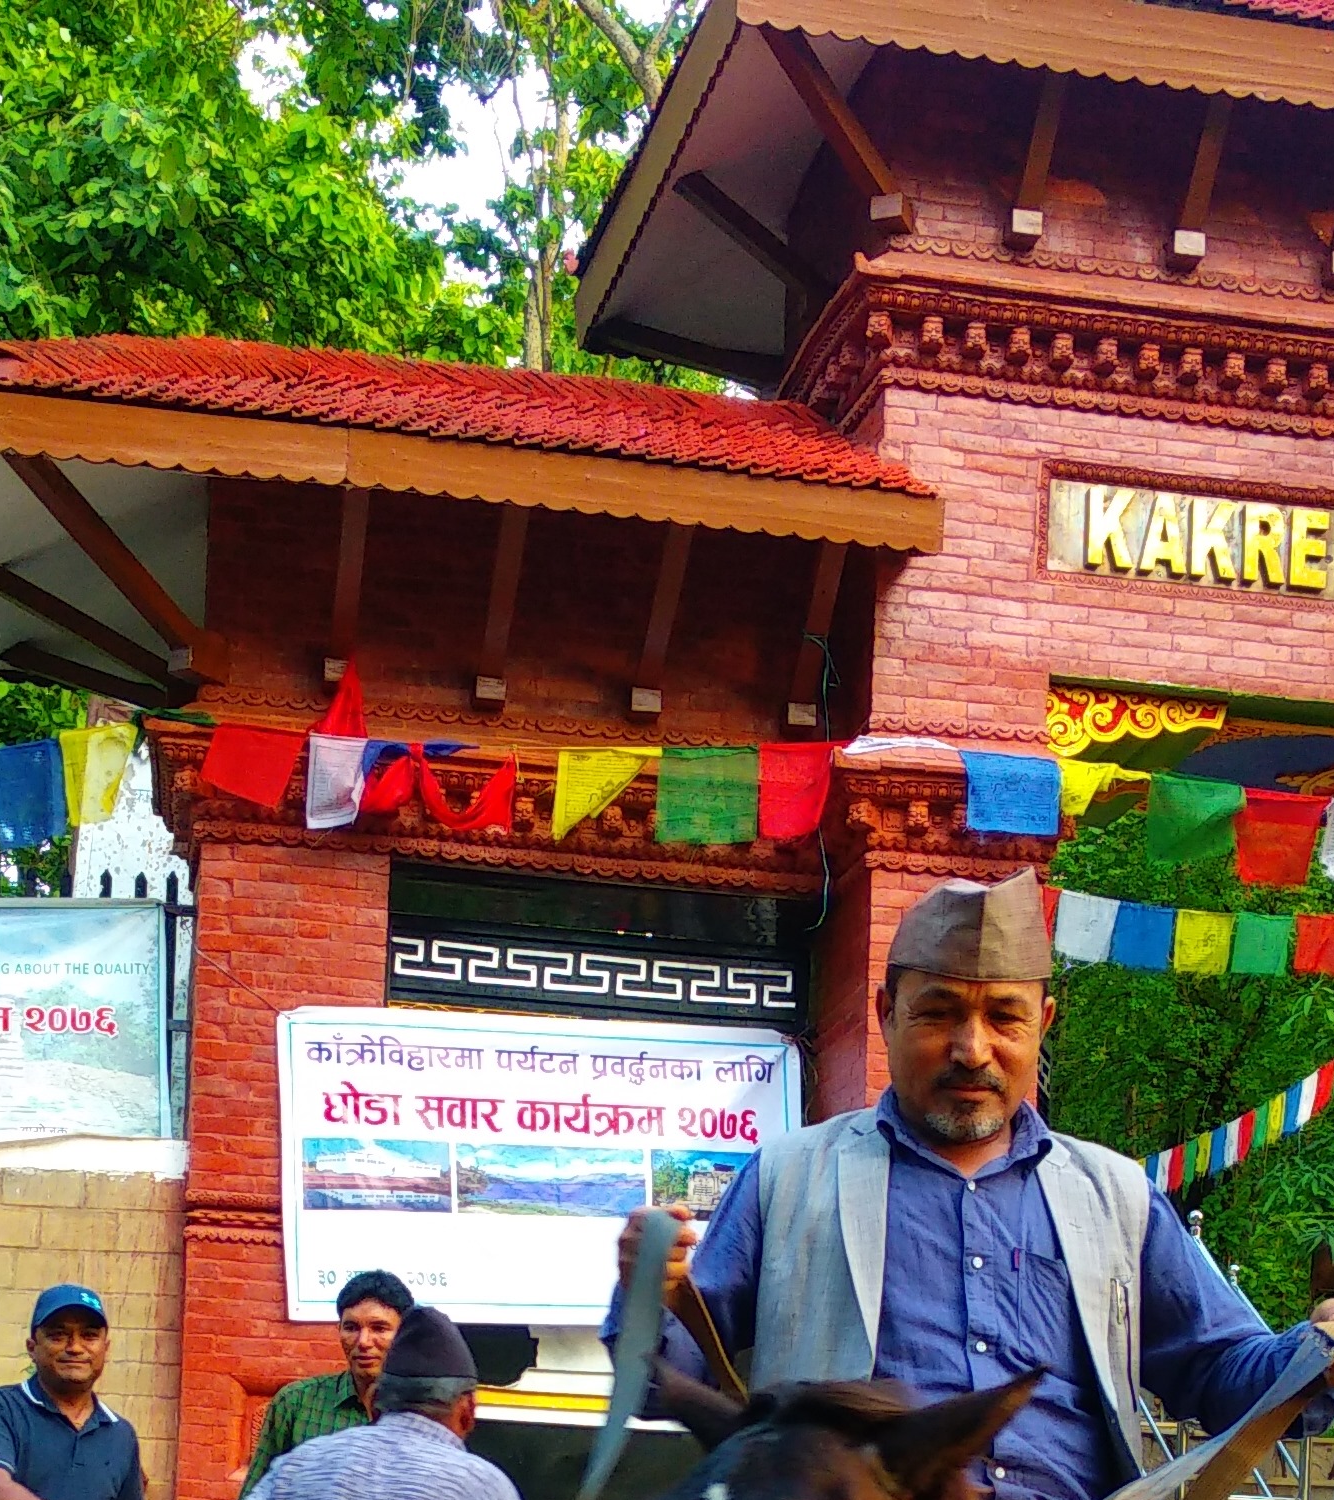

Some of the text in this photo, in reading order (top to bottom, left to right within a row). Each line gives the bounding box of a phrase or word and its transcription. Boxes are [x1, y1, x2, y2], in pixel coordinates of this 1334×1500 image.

[1084, 485, 1331, 591] KAKRE
[14, 962, 61, 975] ABOUT
[65, 962, 89, 975] THE
[94, 963, 150, 976] QUALITY
[25, 1005, 119, 1036] २०७६
[305, 1033, 484, 1071] काँक्रेविहारमा
[495, 1046, 579, 1075] पर्यटन
[713, 1054, 776, 1084] लागि
[414, 1093, 505, 1132] सवार
[517, 1094, 666, 1138] कार्यक्रम
[678, 1106, 759, 1143] २०७६
